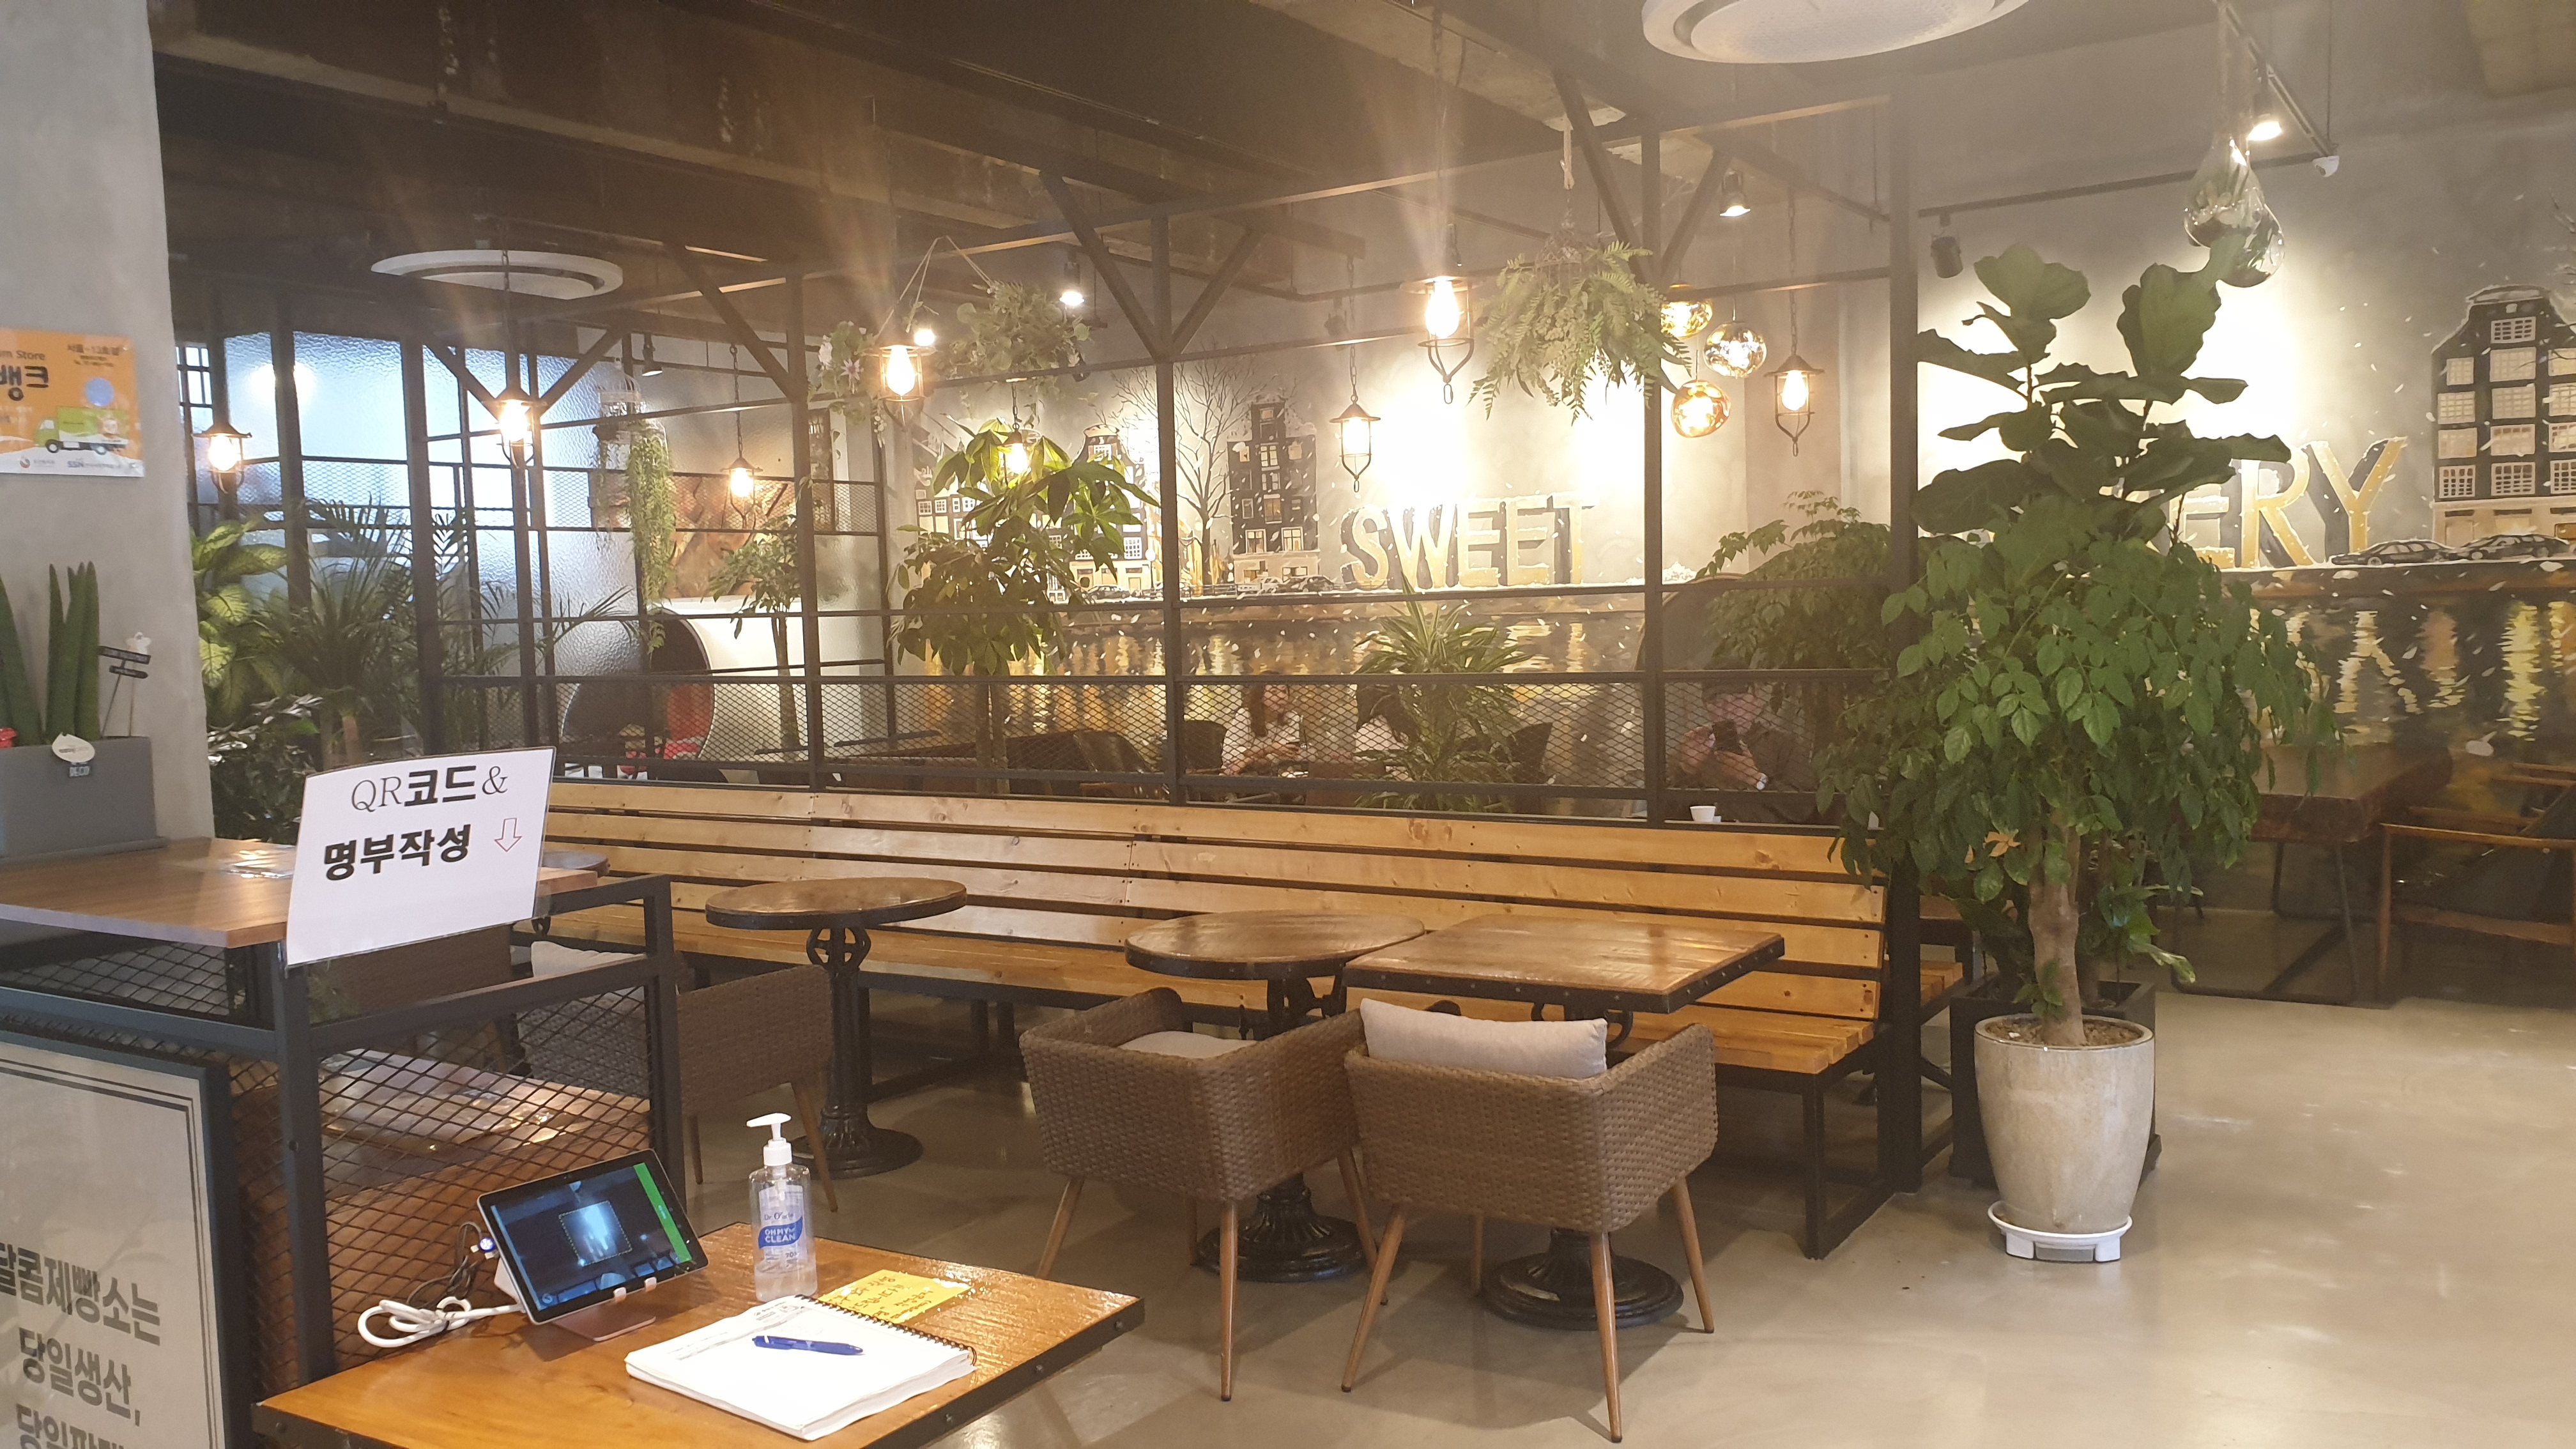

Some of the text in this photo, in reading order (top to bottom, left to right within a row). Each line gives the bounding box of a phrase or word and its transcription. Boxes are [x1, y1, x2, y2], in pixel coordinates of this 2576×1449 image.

[16, 350, 45, 360] Store
[0, 365, 49, 401] 뱅크
[2163, 436, 2407, 569] ERY
[1340, 491, 1595, 591] SWEET
[351, 765, 508, 812] QR코드&
[323, 824, 471, 881] 명부작성
[765, 1234, 795, 1243] CLEAN
[19, 1327, 140, 1427] 당일생산,
[16, 1403, 124, 1449] 당일
